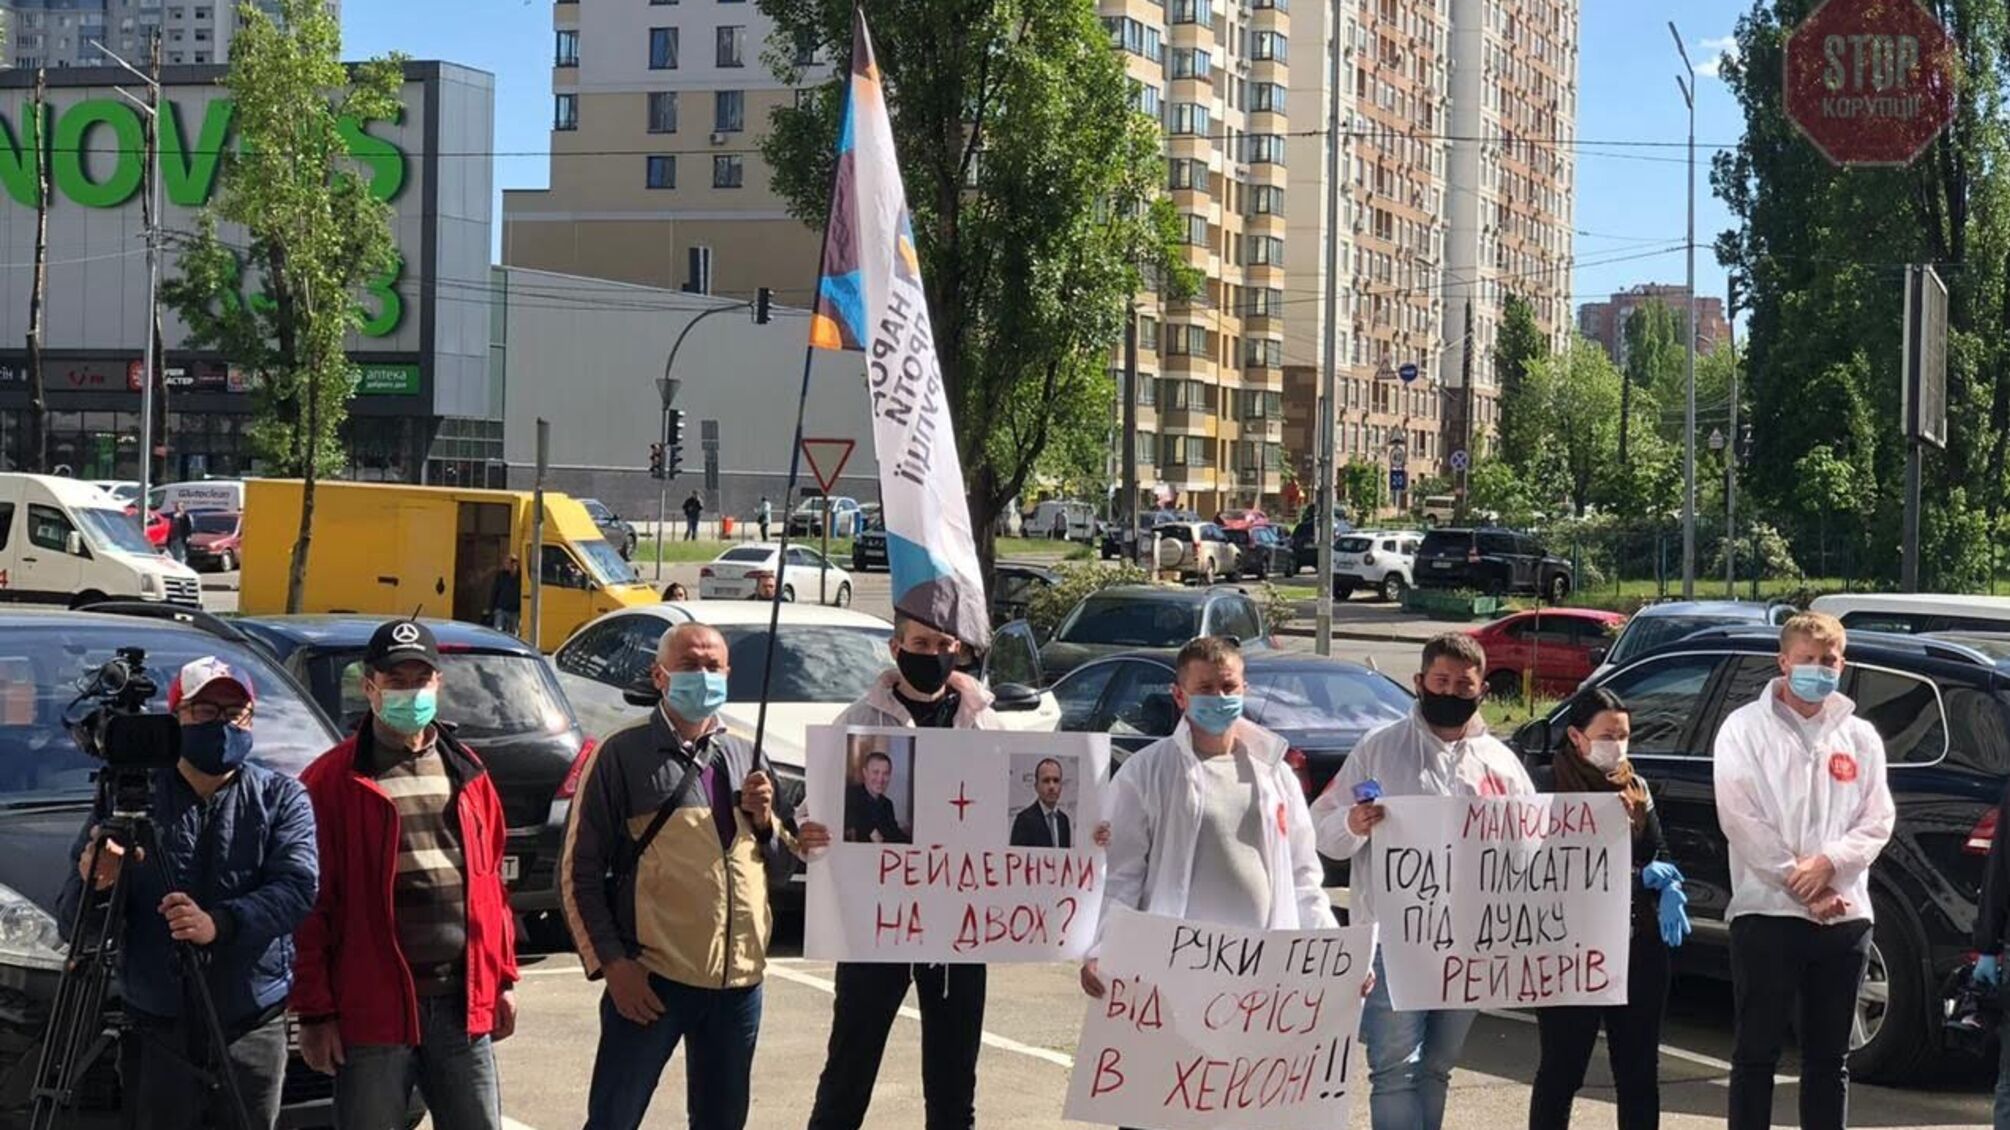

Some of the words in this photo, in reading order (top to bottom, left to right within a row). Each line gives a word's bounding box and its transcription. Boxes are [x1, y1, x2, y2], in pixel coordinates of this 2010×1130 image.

[0, 97, 404, 209] NOVS
[366, 369, 407, 380] аптека
[1463, 801, 1597, 841] МАЛЮСЬКА
[878, 844, 1095, 892] РЕЙДЕРНУЛИ
[1479, 845, 1610, 894] ПЛЯСАТИ
[875, 901, 925, 948] НА
[952, 897, 1078, 953] ДВОХ?
[1474, 900, 1568, 953] ДУДКУ
[1168, 925, 1265, 977] РУКИ
[1286, 937, 1352, 979] ГЕТЬ
[1090, 1047, 1125, 1098] В
